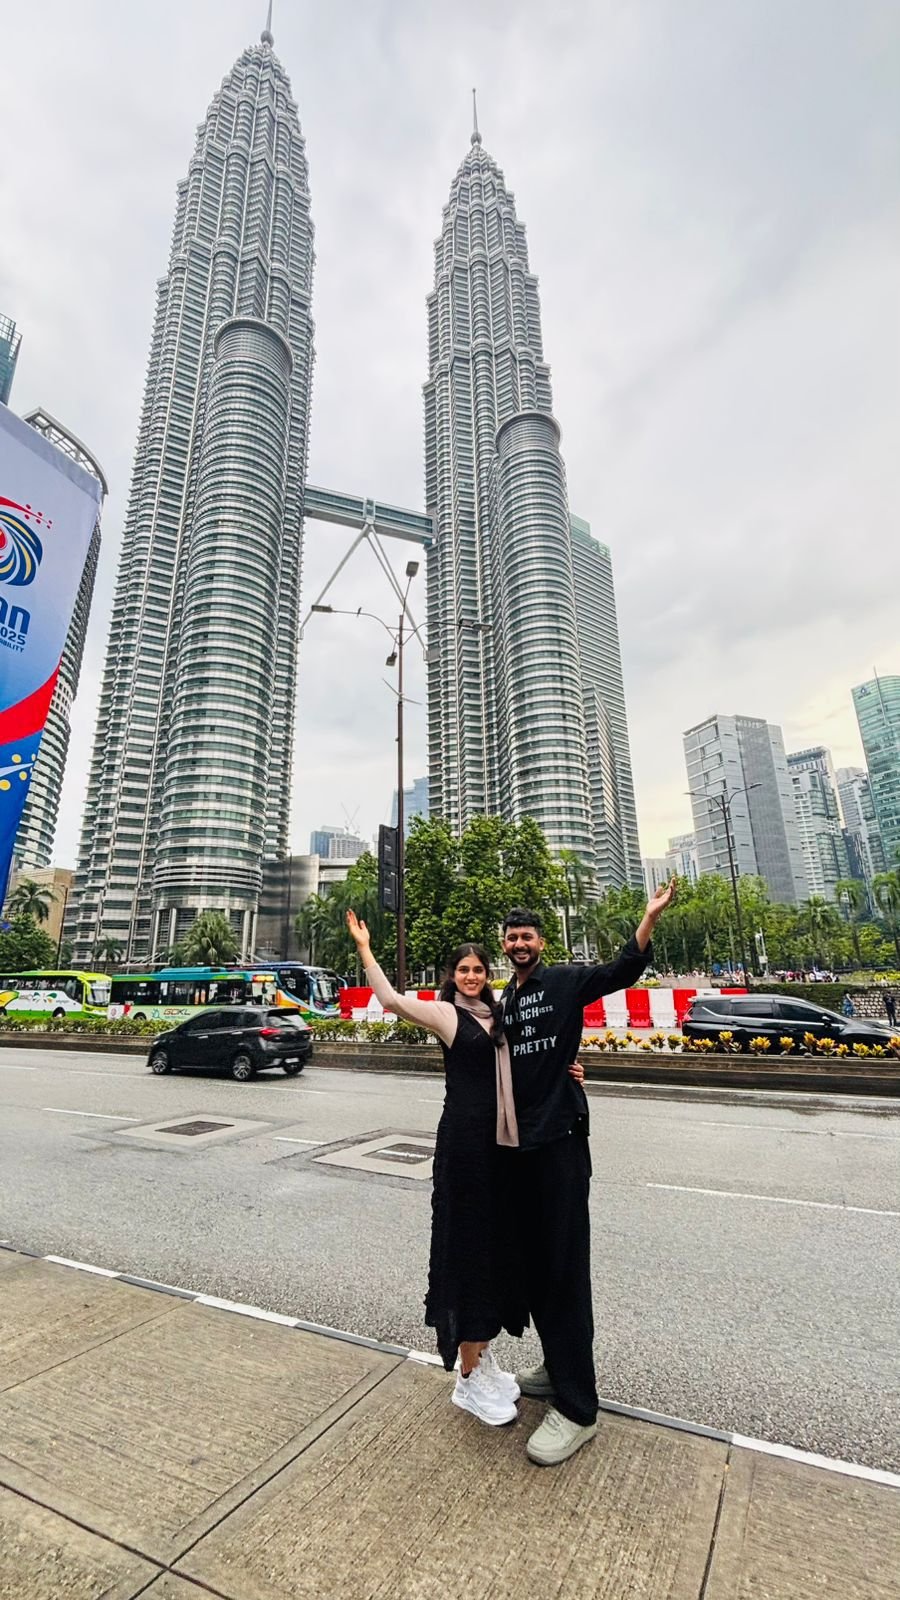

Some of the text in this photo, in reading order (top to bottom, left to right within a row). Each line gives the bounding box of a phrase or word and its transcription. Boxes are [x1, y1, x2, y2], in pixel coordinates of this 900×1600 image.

[520, 990, 545, 1008] ONLY
[504, 1005, 554, 1026] ARCHISTS
[513, 1035, 557, 1057] PRETTY
